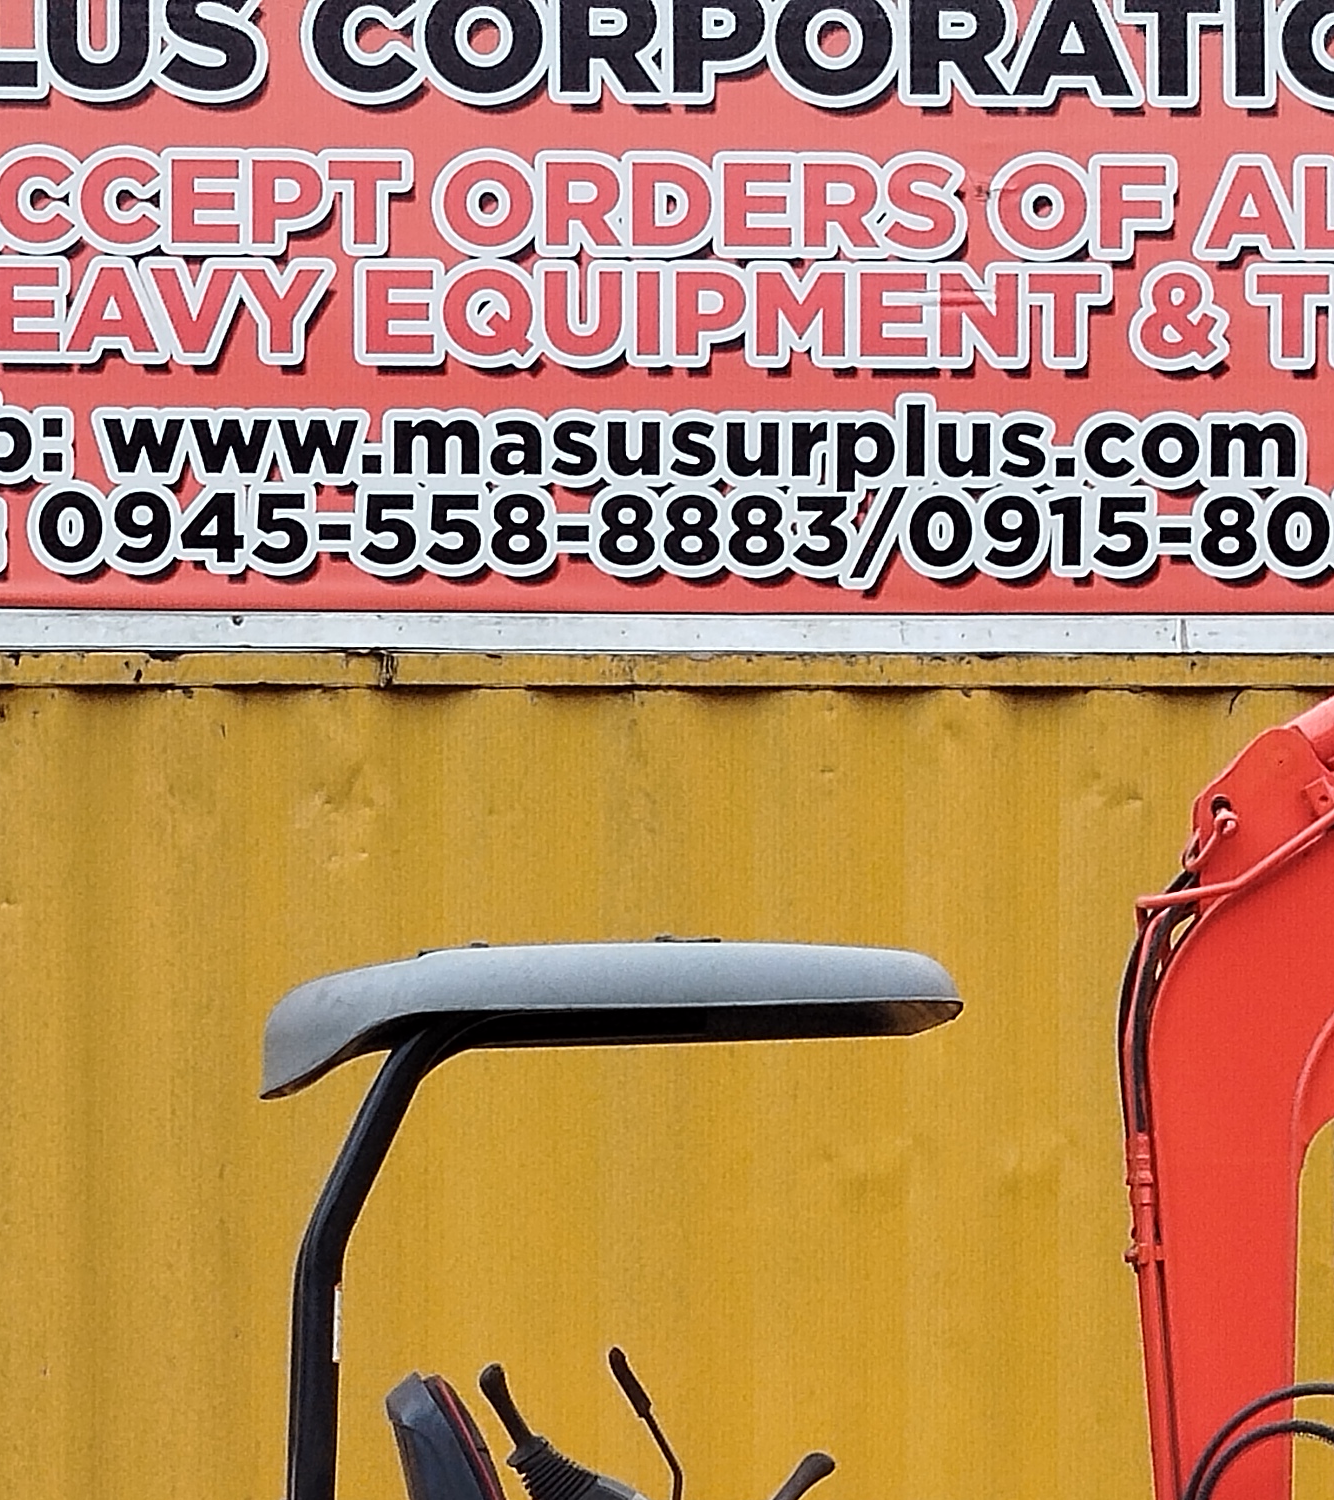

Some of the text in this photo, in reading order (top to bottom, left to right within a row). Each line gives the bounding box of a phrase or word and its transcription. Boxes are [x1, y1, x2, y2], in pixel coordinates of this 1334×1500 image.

[433, 149, 967, 260] ORDERS
[989, 151, 1178, 260] OF
[354, 258, 1113, 370] EQUIPMENT
[1129, 261, 1229, 370] &
[94, 395, 1307, 495] www.masusurplus.com
